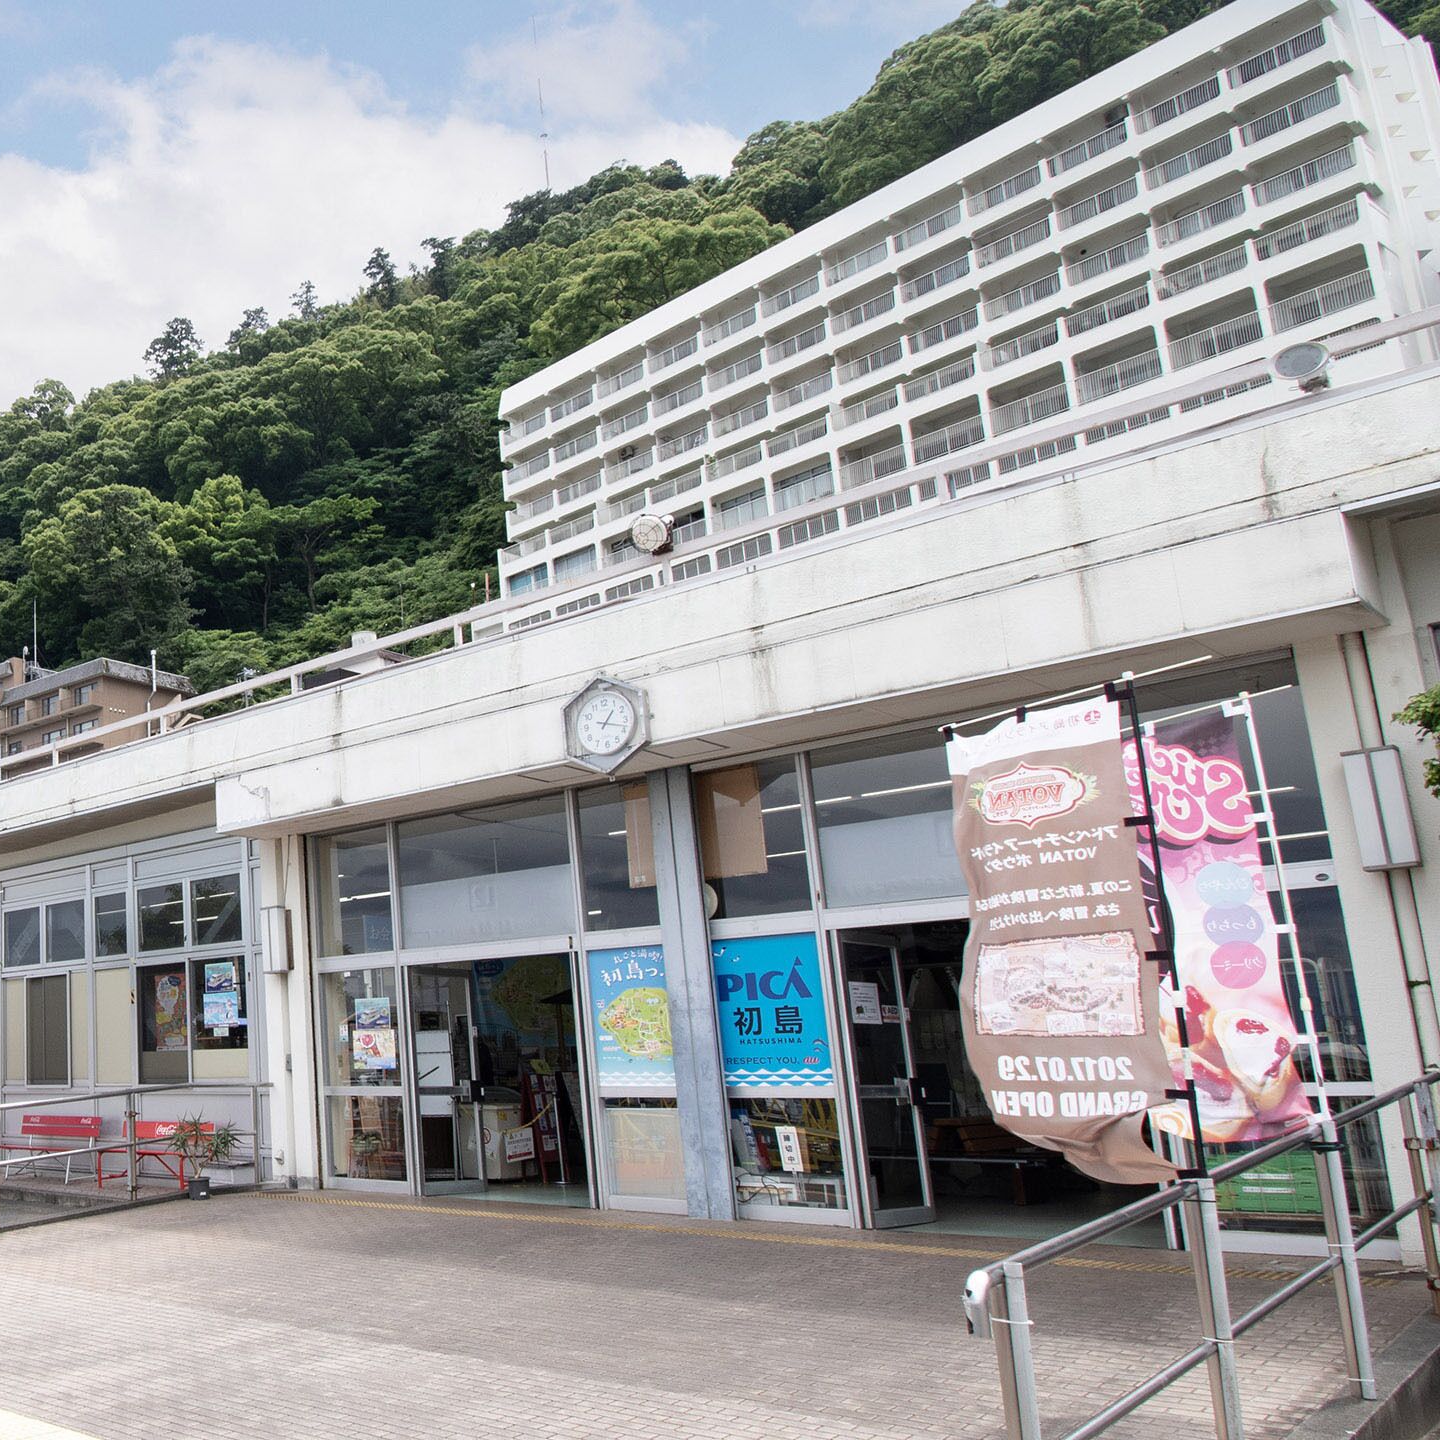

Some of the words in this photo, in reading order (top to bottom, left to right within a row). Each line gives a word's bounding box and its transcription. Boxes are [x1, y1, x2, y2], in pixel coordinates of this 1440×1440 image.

[600, 960, 665, 987] 初島っ
[717, 956, 813, 1002] PICA
[733, 1005, 803, 1036] 初島
[726, 1057, 773, 1065] RESPECT
[776, 1057, 800, 1065] YOU.
